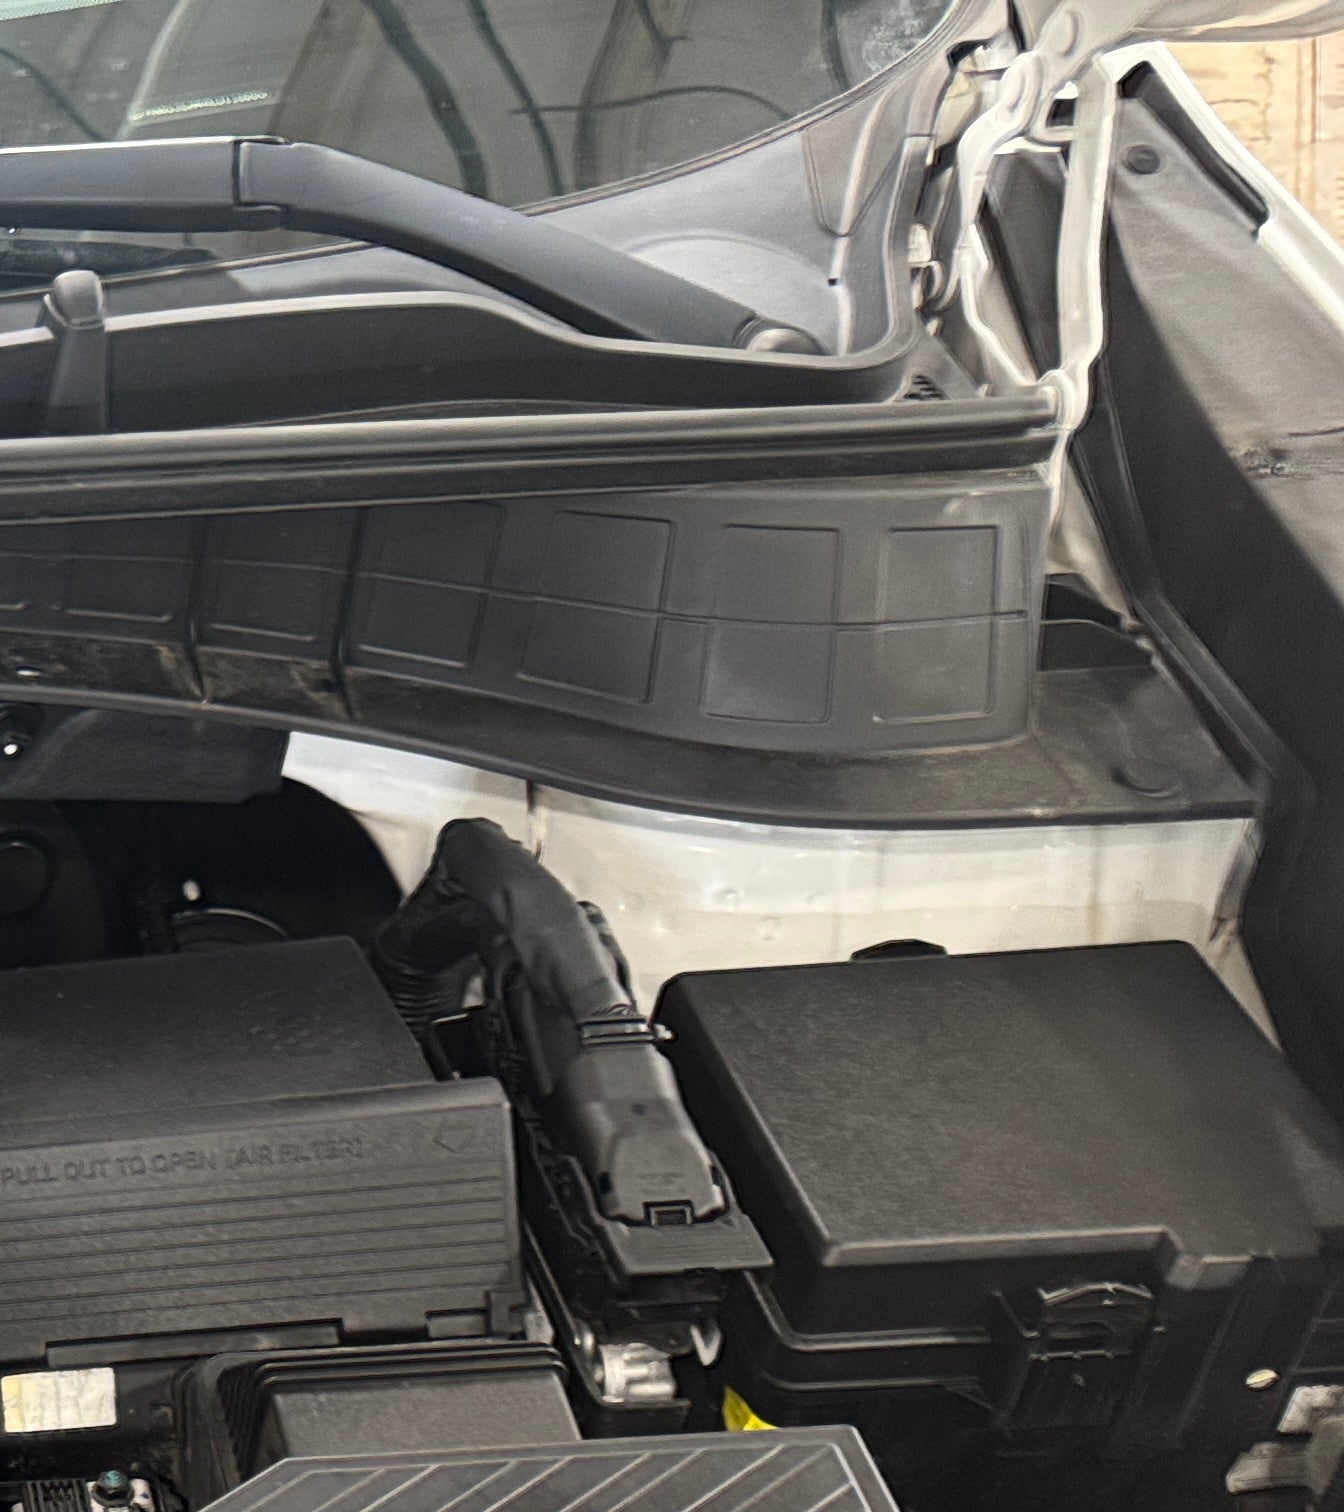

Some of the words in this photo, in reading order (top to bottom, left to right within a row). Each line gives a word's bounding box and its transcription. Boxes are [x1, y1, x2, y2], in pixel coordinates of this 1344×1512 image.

[1, 1163, 59, 1191] PULL
[64, 1159, 110, 1182] OUT
[115, 1155, 146, 1177] TO
[152, 1149, 217, 1174] OPEN
